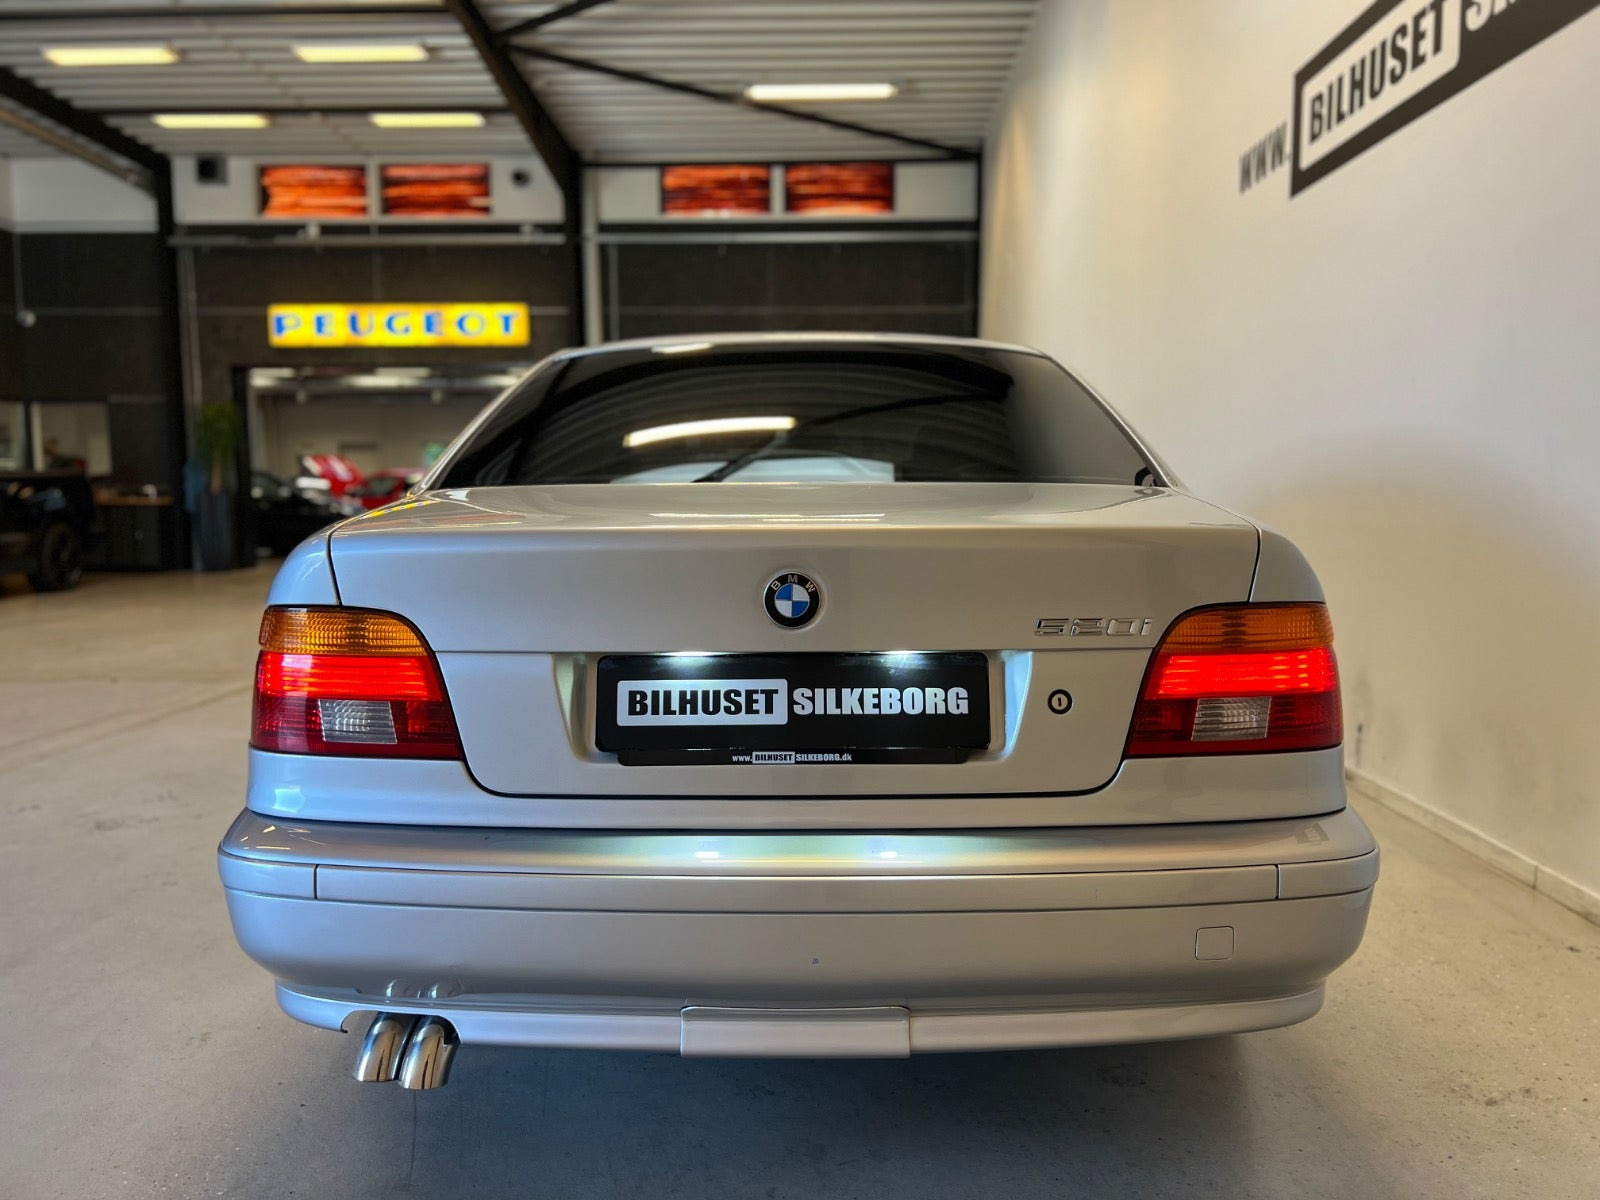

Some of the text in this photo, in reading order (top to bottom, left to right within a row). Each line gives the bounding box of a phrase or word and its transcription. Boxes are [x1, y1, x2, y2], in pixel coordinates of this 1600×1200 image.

[1310, 0, 1444, 145] BILHUSET
[273, 312, 519, 337] PEUGEOT
[770, 574, 816, 592] BMW
[1034, 617, 1153, 636] 520i
[628, 687, 969, 716] BILHUSET SILKEBORG
